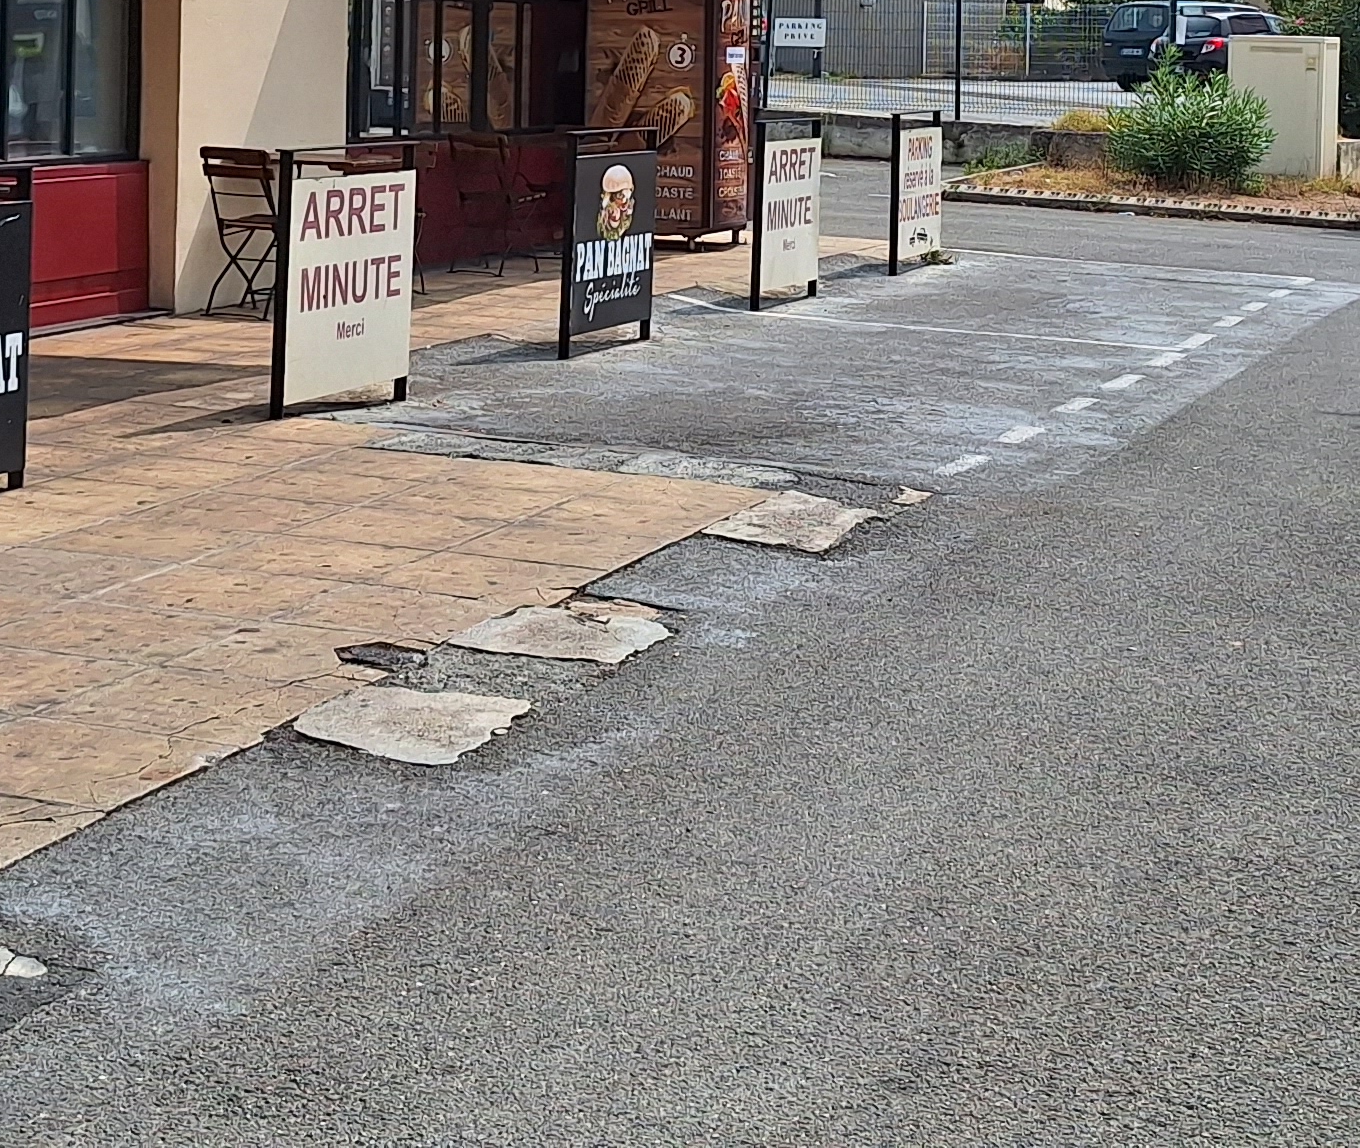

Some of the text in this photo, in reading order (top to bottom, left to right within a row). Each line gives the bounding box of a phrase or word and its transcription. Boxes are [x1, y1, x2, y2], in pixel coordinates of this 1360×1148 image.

[778, 21, 823, 30] PARKING
[674, 47, 687, 65] 3
[768, 147, 816, 185] ARRET
[907, 135, 933, 162] PARKING
[655, 185, 694, 200] OASTÉ
[300, 183, 406, 242] ARRET
[767, 195, 814, 232] MINUTE
[576, 233, 653, 283] PAN BAGNAT
[300, 254, 402, 314] MINUTE
[583, 272, 641, 322] Spécialité
[336, 317, 365, 341] Merci
